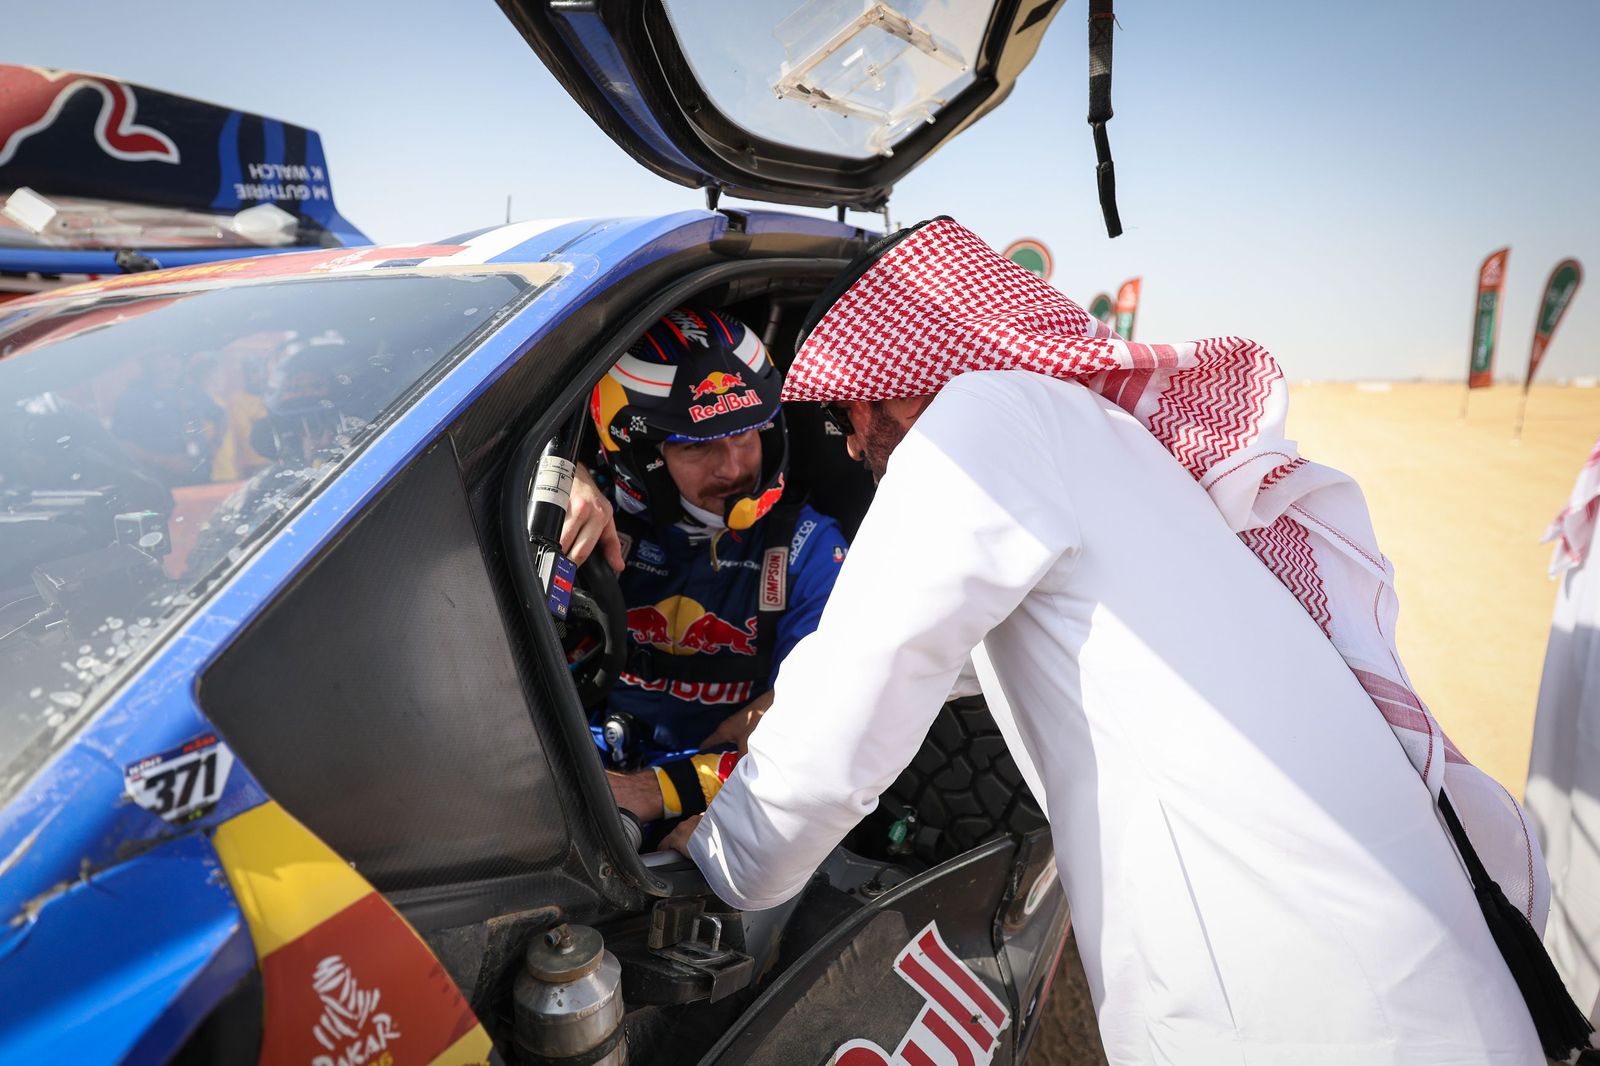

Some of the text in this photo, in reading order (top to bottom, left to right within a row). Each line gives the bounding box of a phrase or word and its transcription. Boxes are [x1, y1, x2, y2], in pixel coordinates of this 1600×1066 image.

[248, 163, 324, 182] K WALCH
[233, 183, 328, 201] M GUTHRIE
[688, 389, 763, 423] Red Bull
[610, 425, 631, 443] Stilo
[766, 554, 782, 604] SIMPSON
[144, 752, 217, 815] 371
